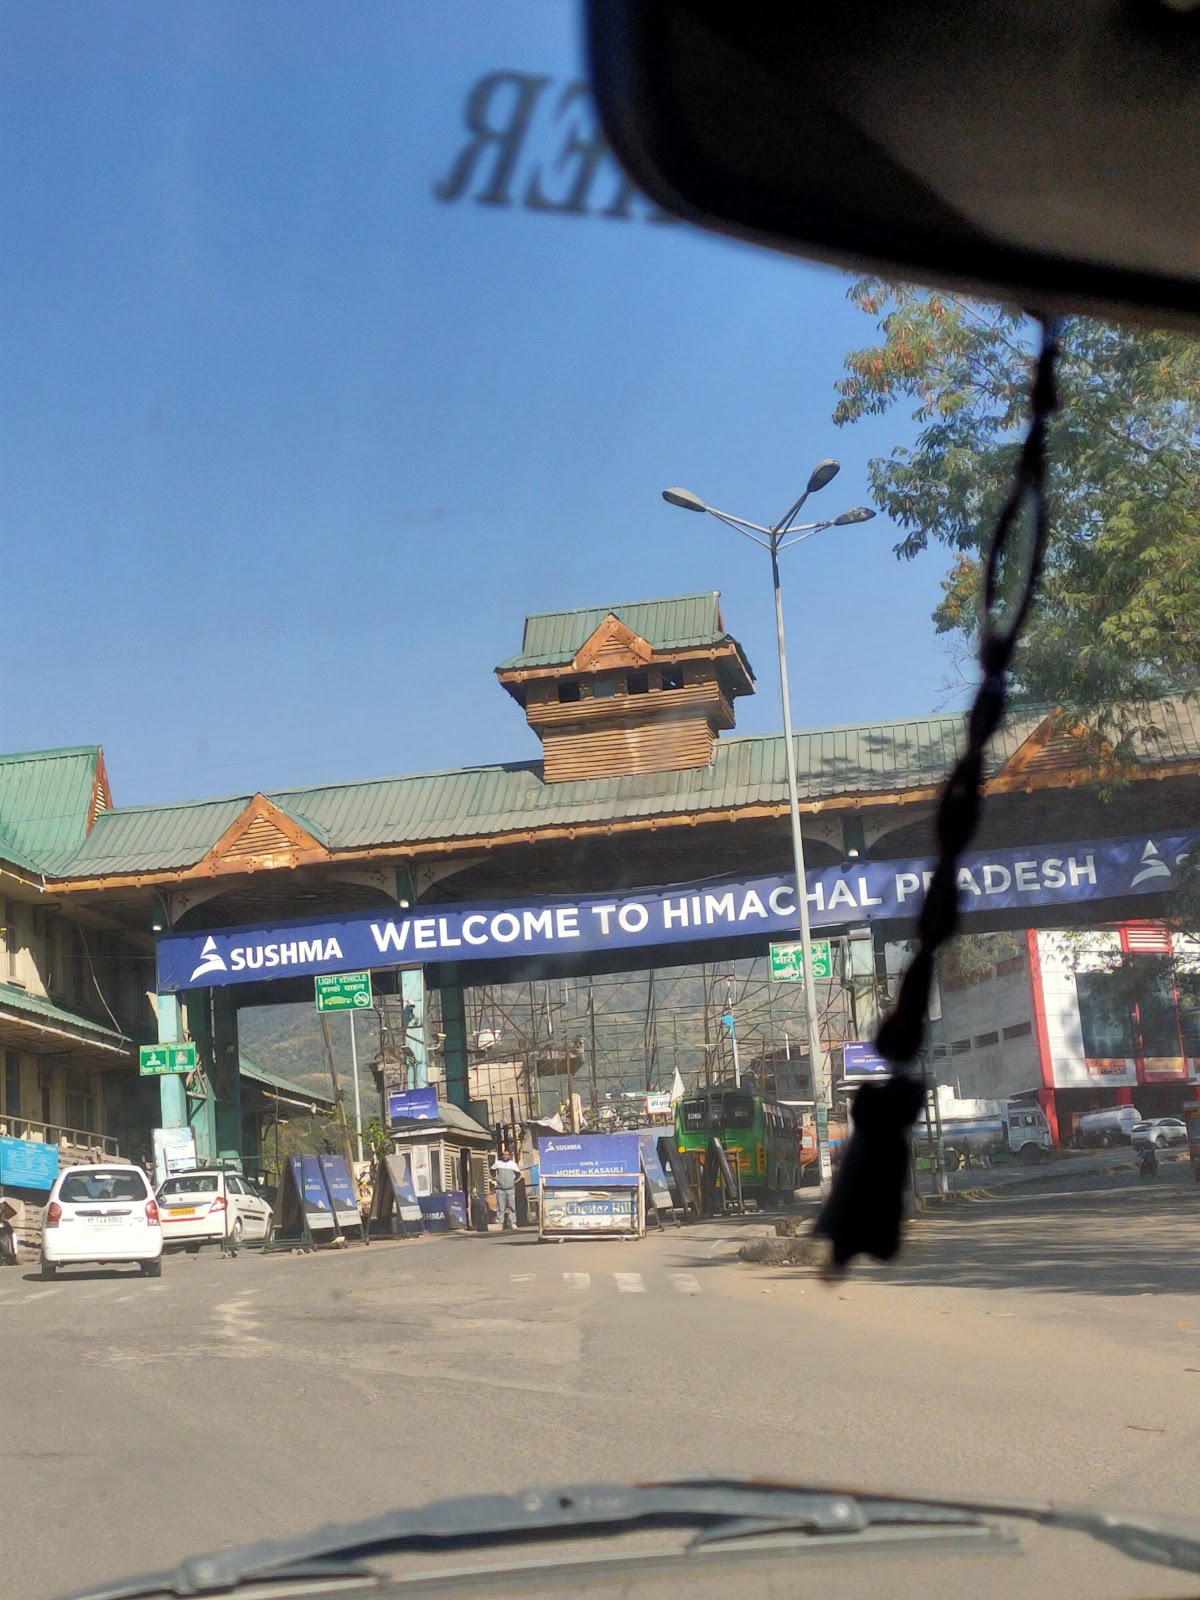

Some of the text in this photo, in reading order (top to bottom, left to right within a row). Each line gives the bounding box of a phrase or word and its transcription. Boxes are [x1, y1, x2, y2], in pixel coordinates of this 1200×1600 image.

[370, 855, 1097, 953] WELCOME TO HIMACHAL PADESH
[231, 937, 344, 971] SUSHMA
[317, 974, 367, 986] LIGHT VEHICLE
[555, 1143, 582, 1151] SUSHMA
[588, 1166, 624, 1174] KASAULI
